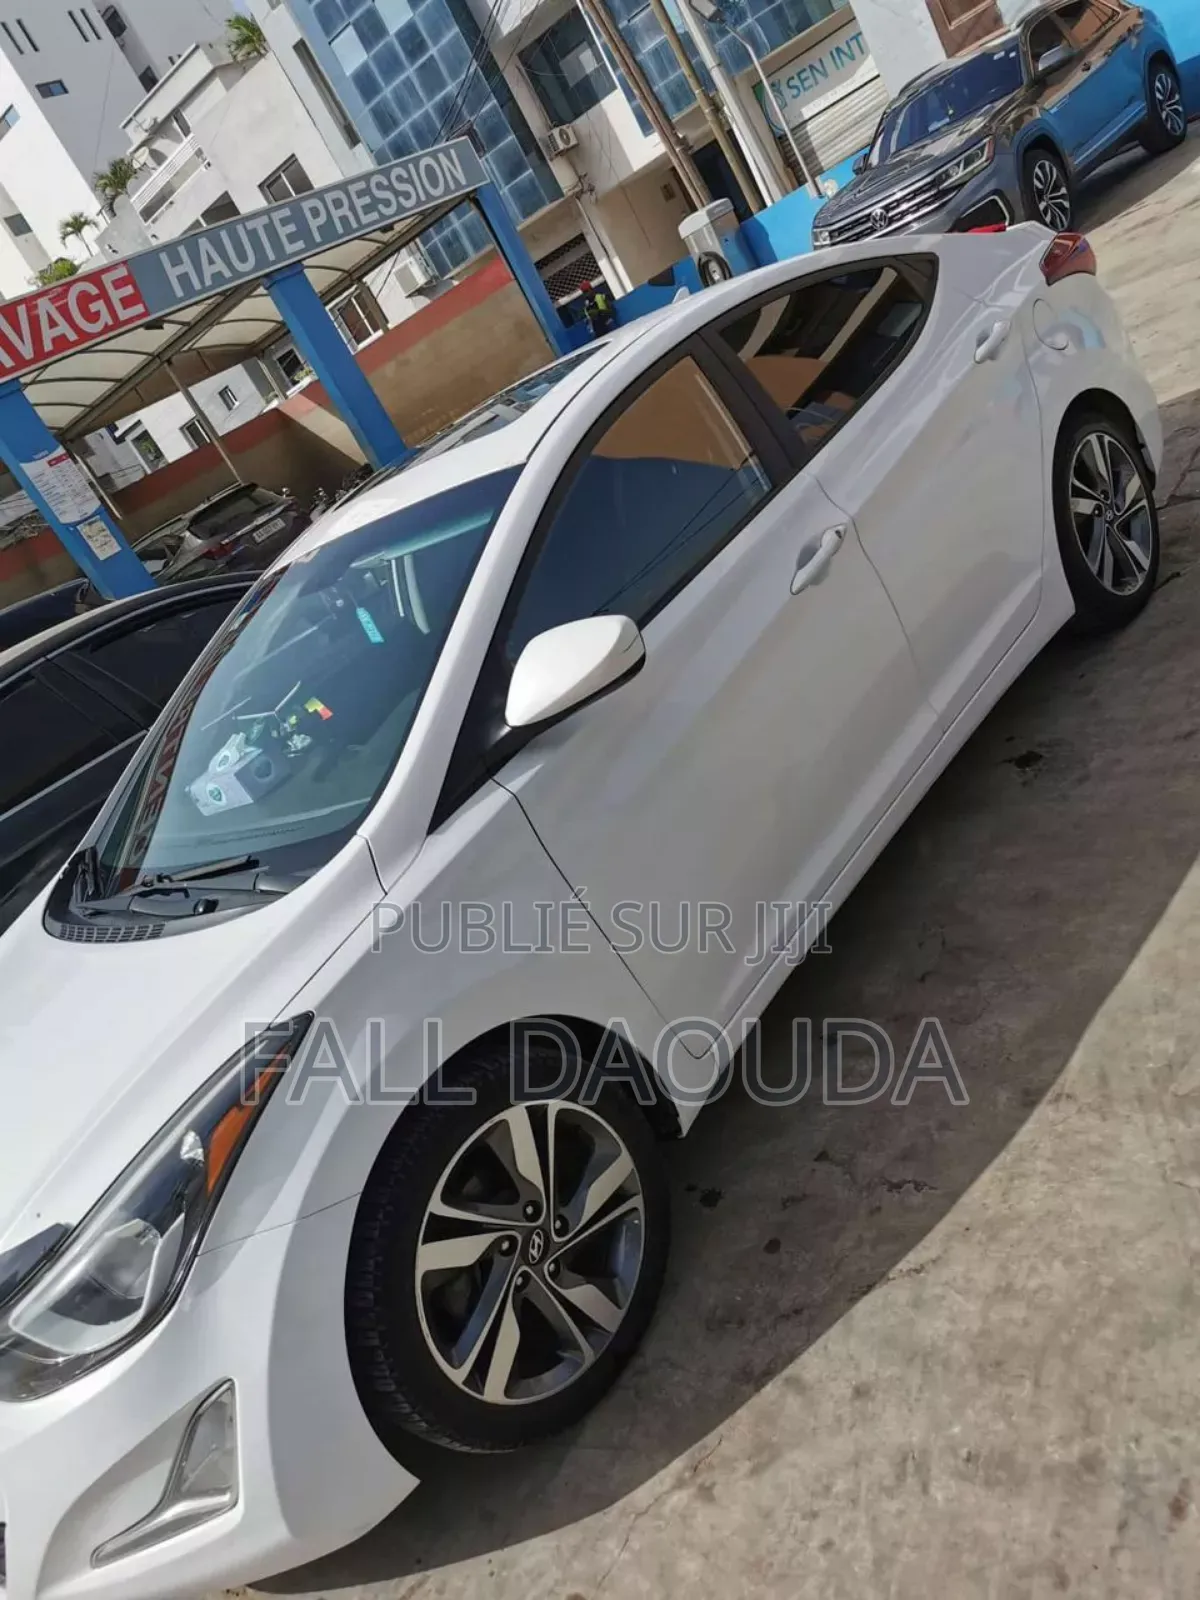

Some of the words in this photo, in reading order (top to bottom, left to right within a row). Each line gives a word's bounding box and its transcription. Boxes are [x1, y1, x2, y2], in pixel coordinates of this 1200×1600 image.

[786, 57, 829, 99] SEN
[829, 31, 865, 70] INT
[159, 207, 306, 298] HAUTE
[300, 148, 467, 242] PRESSION
